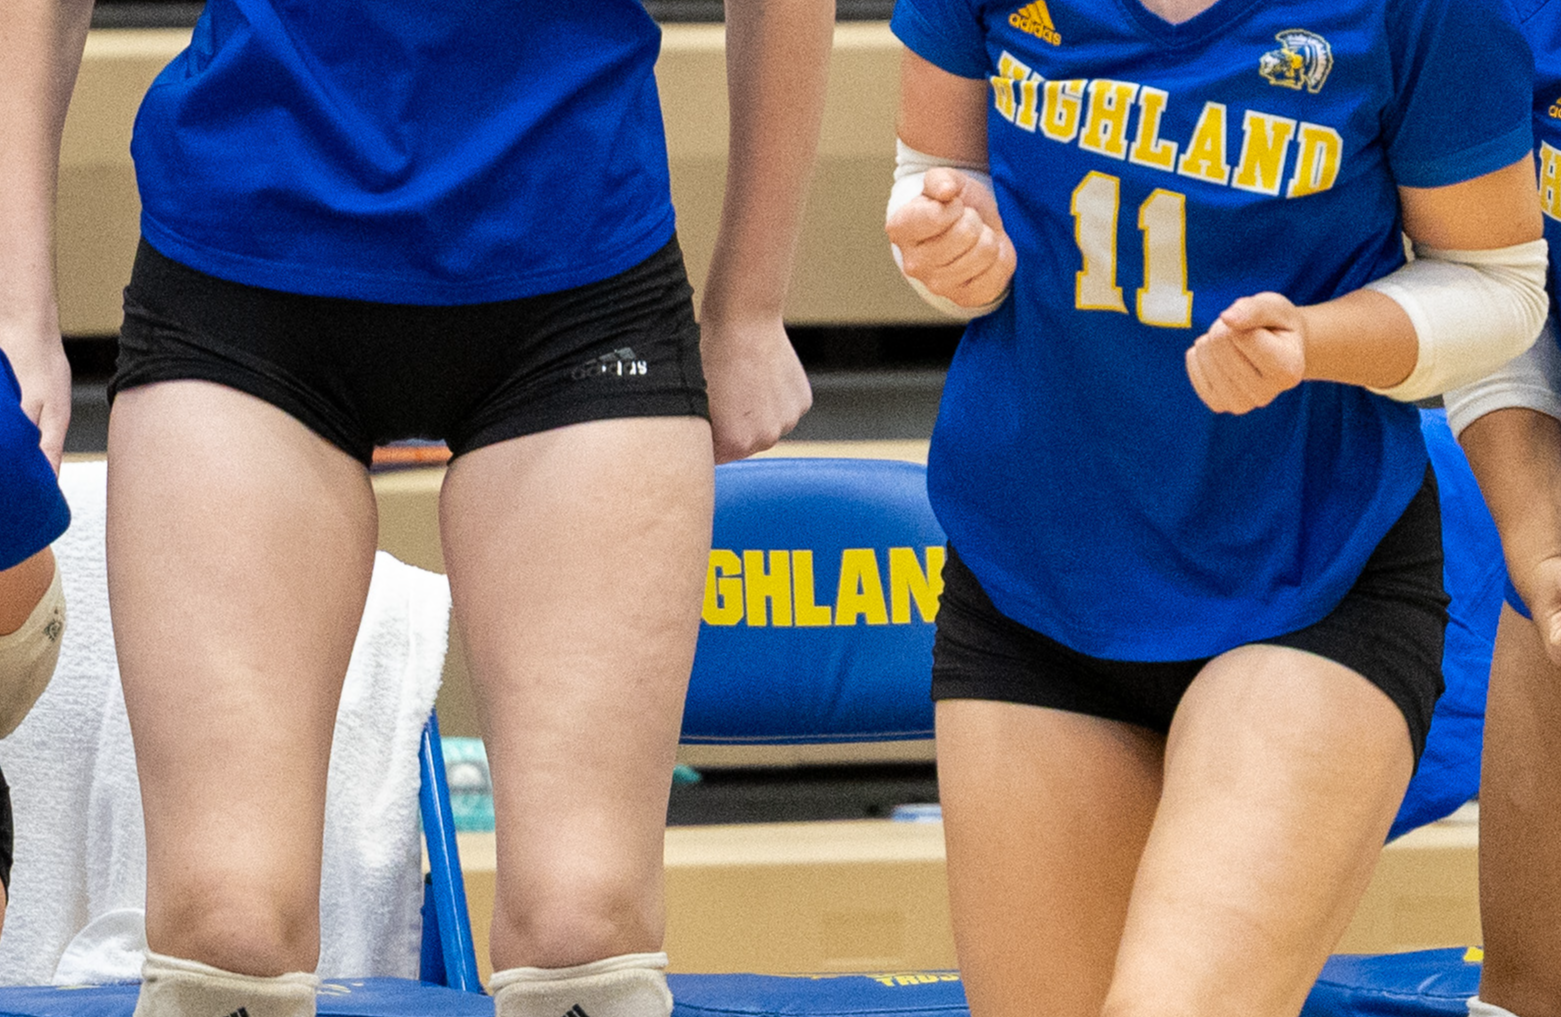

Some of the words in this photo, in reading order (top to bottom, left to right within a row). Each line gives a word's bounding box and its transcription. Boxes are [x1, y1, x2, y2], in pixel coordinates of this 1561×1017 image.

[1008, 11, 1062, 46] adidas
[991, 50, 1344, 199] HIGHLAND
[1070, 170, 1194, 328] 11
[701, 546, 946, 627] GHLAN
